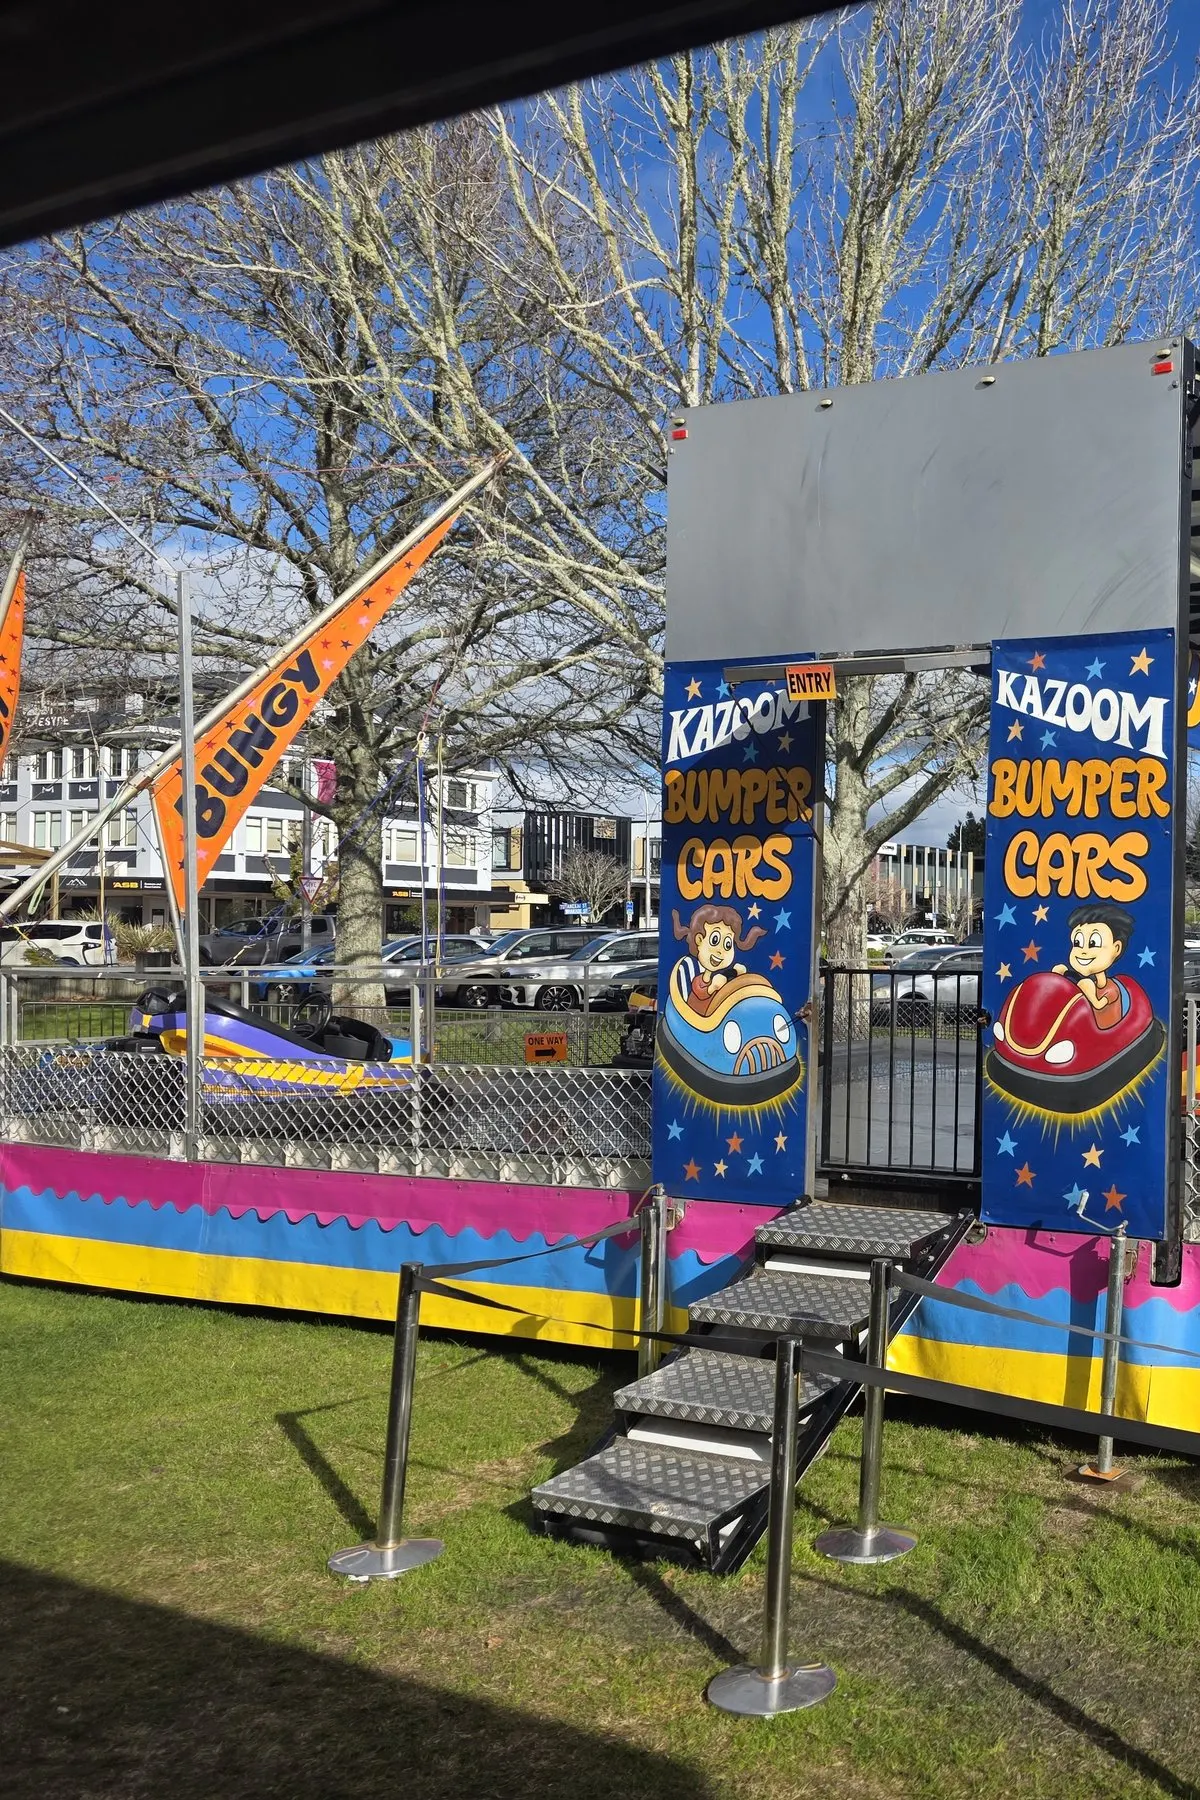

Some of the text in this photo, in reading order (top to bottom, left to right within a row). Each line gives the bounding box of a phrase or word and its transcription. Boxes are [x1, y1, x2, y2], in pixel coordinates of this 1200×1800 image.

[789, 672, 833, 695] ENTRY
[995, 669, 1170, 760] KAZOOM
[174, 648, 321, 838] BUNGY
[665, 689, 811, 764] KAZOOM
[663, 767, 813, 825] BUMPER
[987, 756, 1172, 819] BUMPER
[113, 881, 139, 889] ASB
[676, 833, 793, 900] CARS
[1003, 829, 1150, 903] CARS
[528, 1037, 563, 1045] ONE WAY
